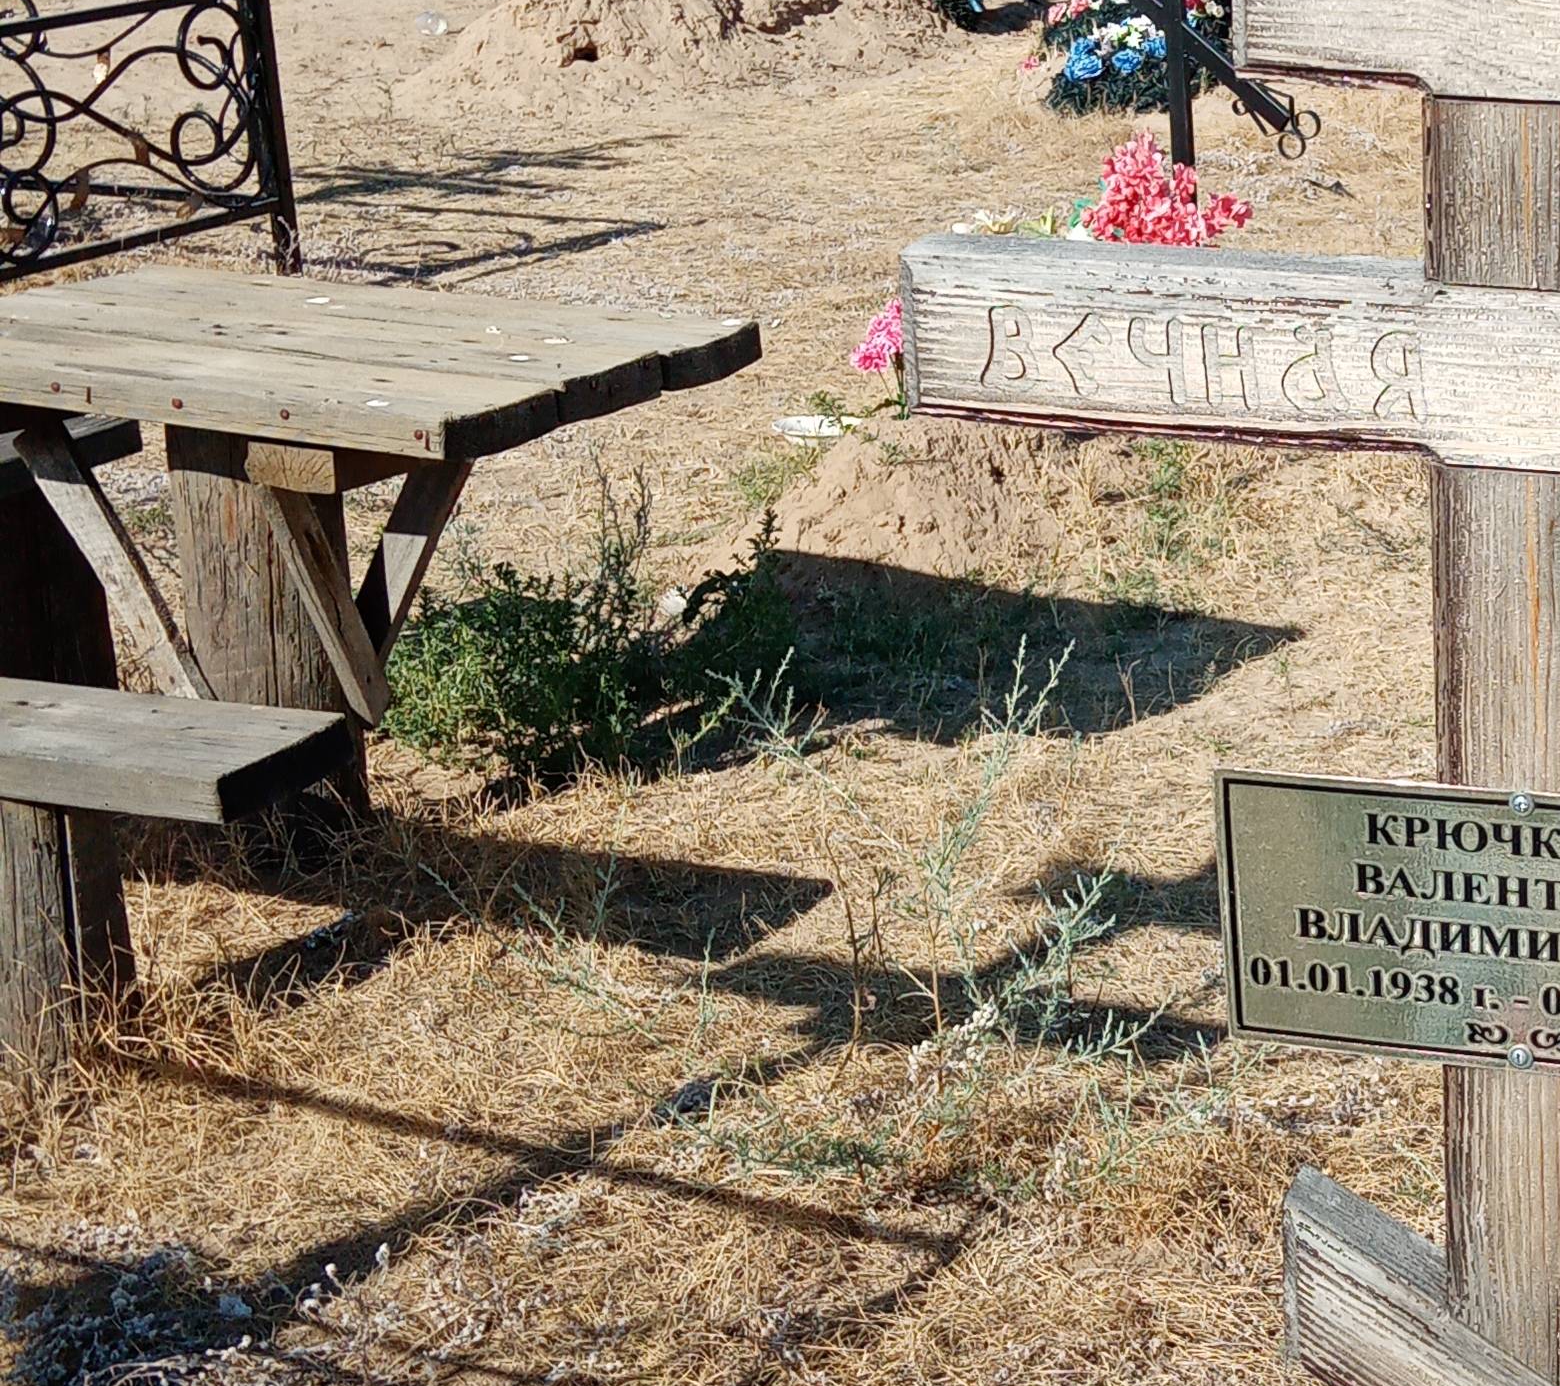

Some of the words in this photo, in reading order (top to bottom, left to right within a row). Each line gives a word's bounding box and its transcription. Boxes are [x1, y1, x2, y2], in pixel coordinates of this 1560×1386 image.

[981, 304, 1427, 424] ВЕЧНАЯ
[1250, 955, 1460, 1006] 01.01.1938
[1475, 987, 1500, 1011] г.
